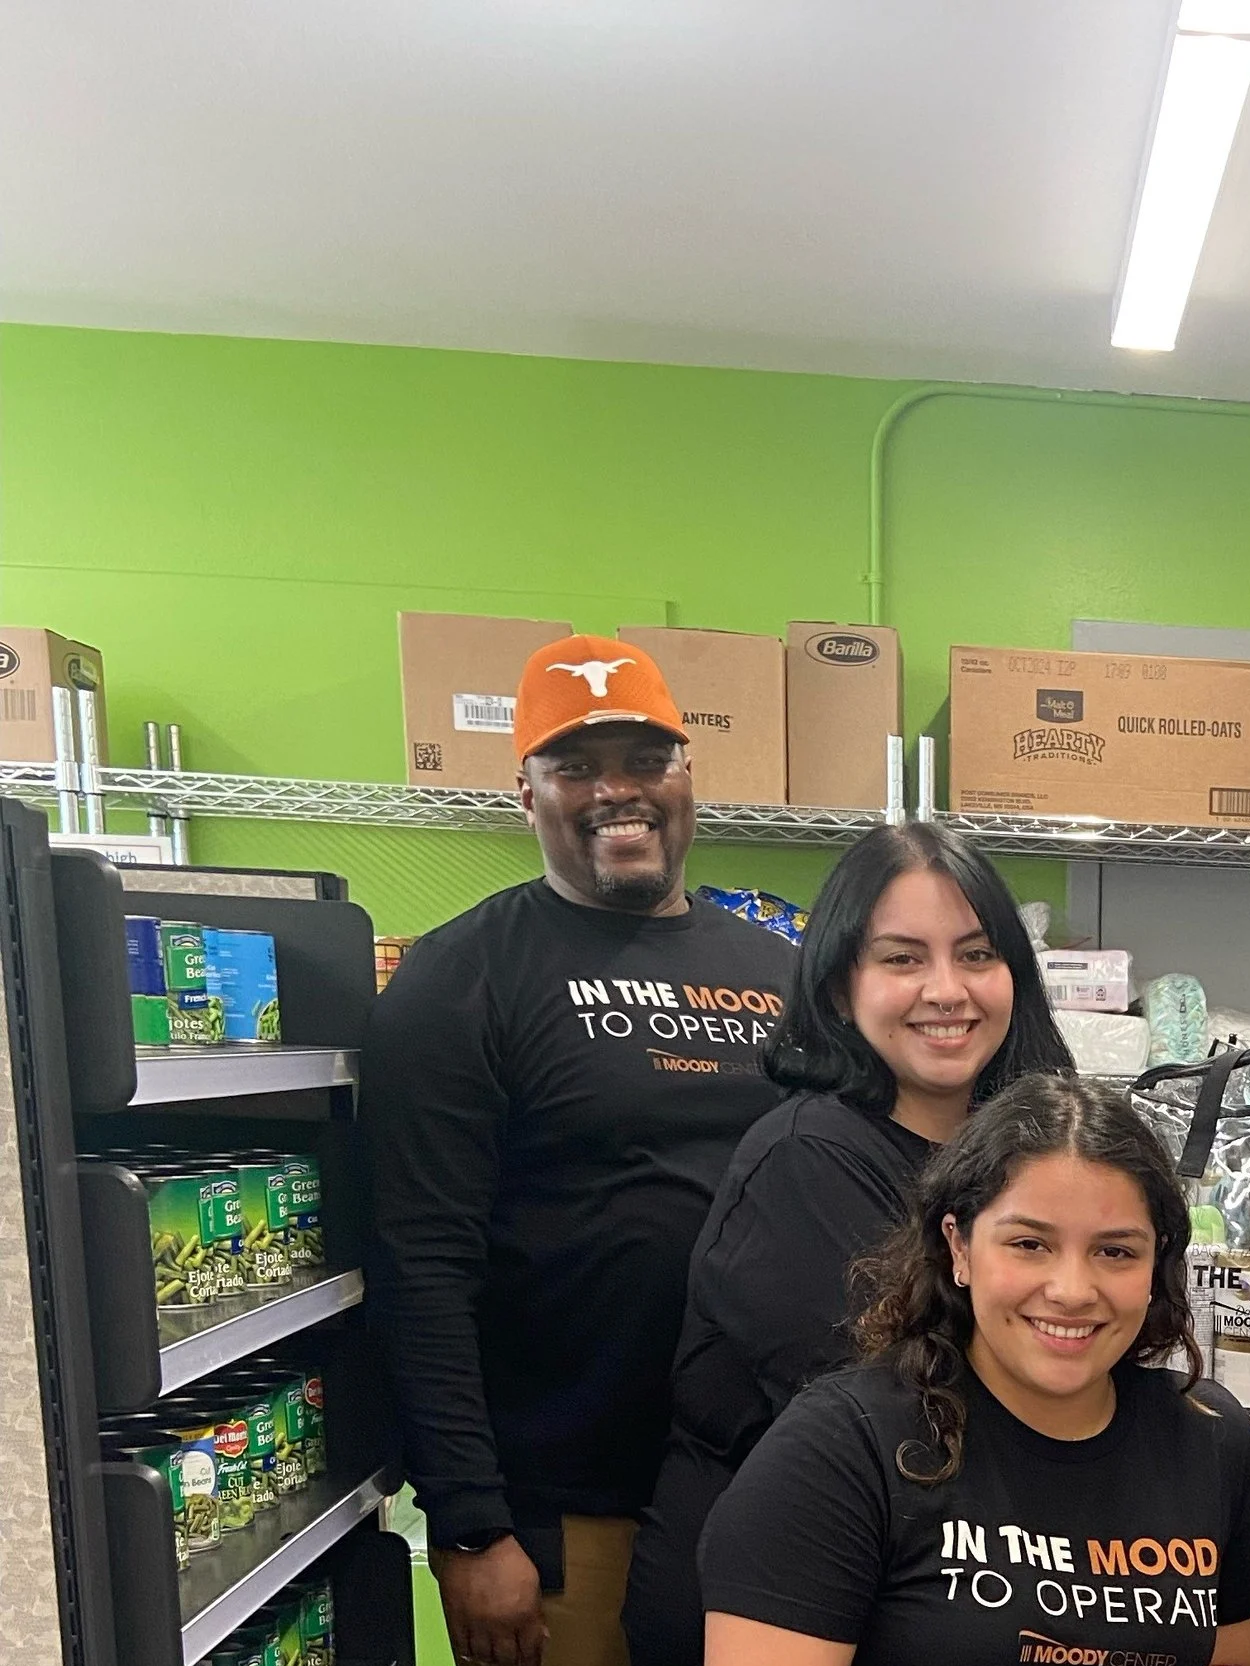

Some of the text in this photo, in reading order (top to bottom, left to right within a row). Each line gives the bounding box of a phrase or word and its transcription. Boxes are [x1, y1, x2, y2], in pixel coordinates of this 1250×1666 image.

[823, 640, 873, 658] Barilla
[682, 711, 731, 729] ANTERS
[1118, 716, 1242, 739] QUICK ROLLED-OATS
[1013, 728, 1106, 763] HEARTY
[1026, 752, 1093, 766] TRADITIONS
[185, 954, 205, 965] Gre
[186, 967, 206, 979] Bea
[568, 979, 611, 1006] IN
[612, 979, 680, 1009] THE
[169, 1017, 203, 1032] jotes
[577, 1011, 775, 1045] TO OPERA
[663, 1057, 720, 1074] MOODY
[225, 1200, 240, 1212] Gre
[226, 1214, 241, 1226] Bea
[216, 1277, 243, 1288] rtado
[1193, 1265, 1243, 1289] THE
[257, 1421, 273, 1434] Gre
[258, 1433, 274, 1447] Bea
[940, 1519, 1219, 1577] IN THE MOOD
[940, 1566, 1219, 1628] TO OPERATE
